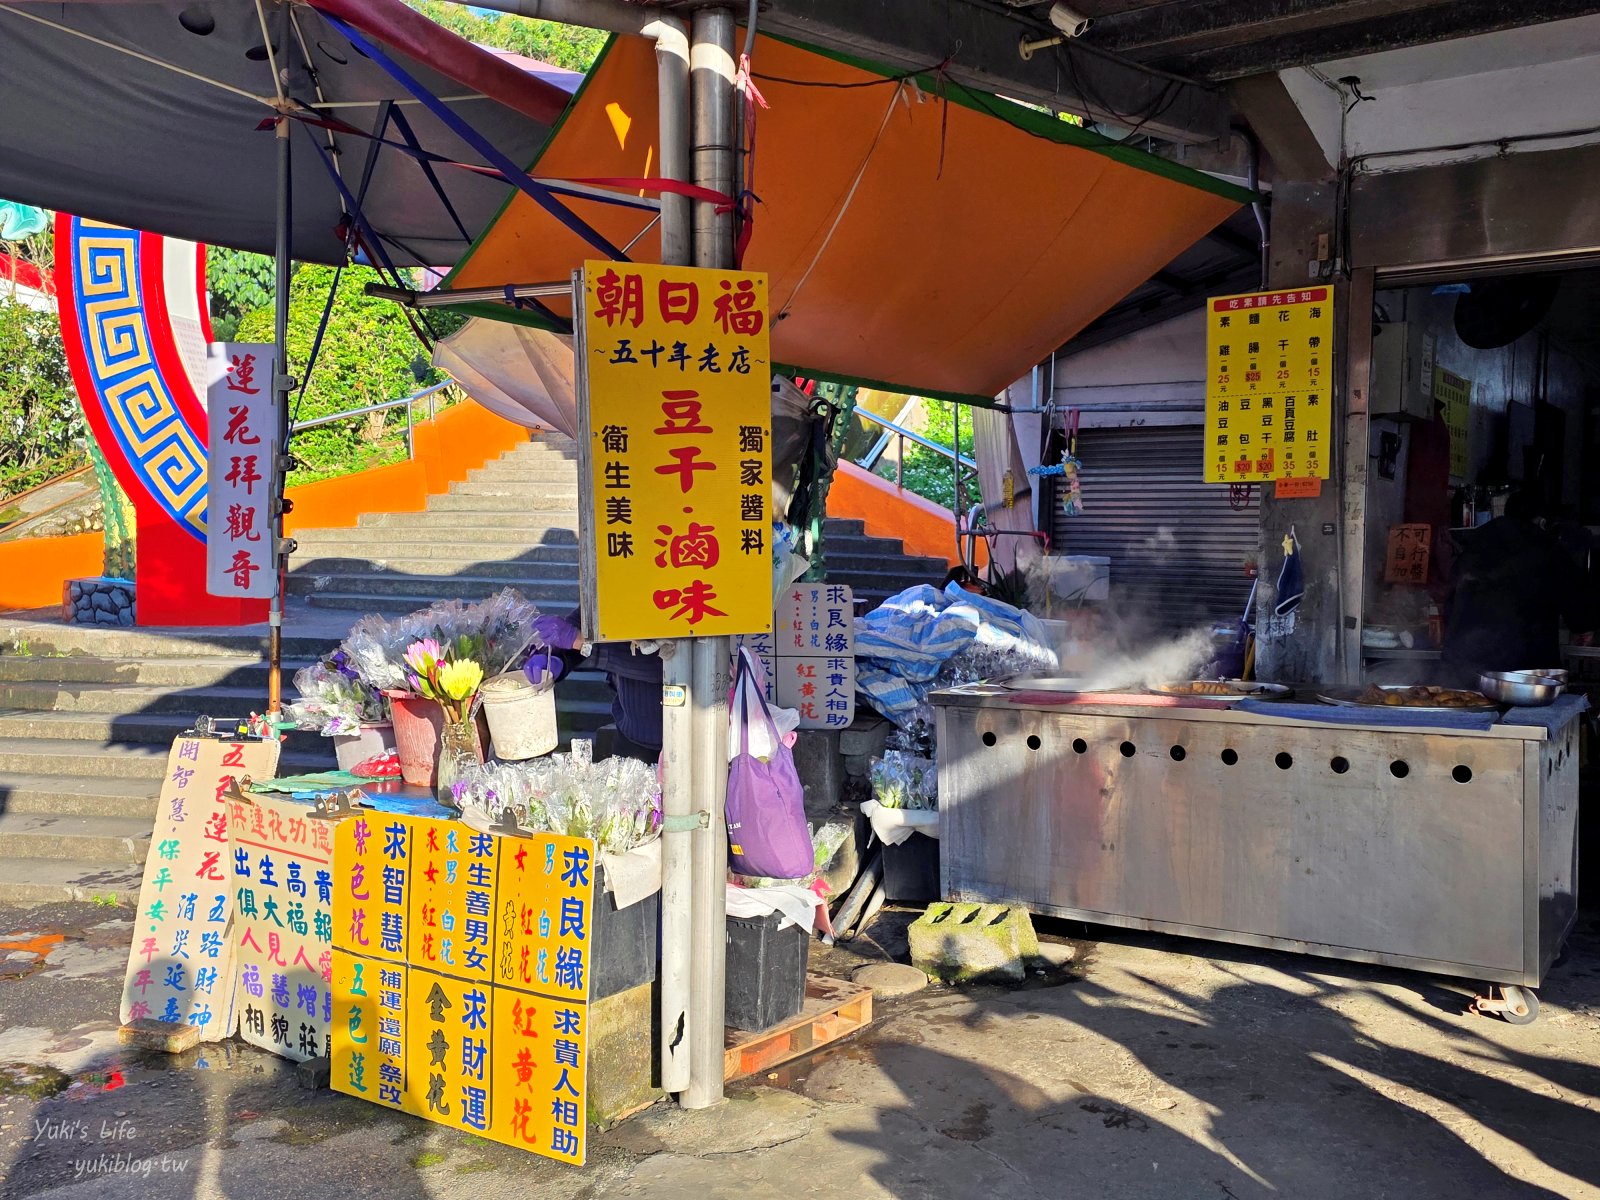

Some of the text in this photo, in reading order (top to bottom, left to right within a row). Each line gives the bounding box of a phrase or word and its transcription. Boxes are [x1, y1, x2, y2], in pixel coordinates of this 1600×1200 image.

[594, 268, 764, 336] 朝日福
[1229, 292, 1312, 309] 吃素請先告知
[1278, 310, 1290, 351] 花干
[1309, 307, 1321, 348] 海帶
[1217, 400, 1229, 446] 油豆腐
[1239, 398, 1251, 445] 豆包
[1261, 397, 1273, 443] 黑豆干
[1283, 396, 1296, 443] 百頁豆腐
[1306, 394, 1319, 442] 素肚
[223, 353, 262, 590] 蓮花拜觀音
[601, 425, 634, 559] 衛生美味
[738, 425, 764, 556] 獨家醬料
[825, 586, 849, 652] 求良緣
[825, 658, 849, 726] 求貴人相助
[234, 846, 333, 906] 出生高貴
[349, 818, 372, 946] 紫色花
[380, 821, 407, 953] 求智慧
[462, 833, 494, 972] 求生善男女
[237, 887, 332, 944] 俱大福報
[554, 845, 590, 991] 求良緣
[187, 895, 226, 1035] 五路財神
[348, 963, 368, 1092] 五色蓮
[461, 988, 487, 1131] 求財運
[551, 1008, 582, 1157] 求貴人相助
